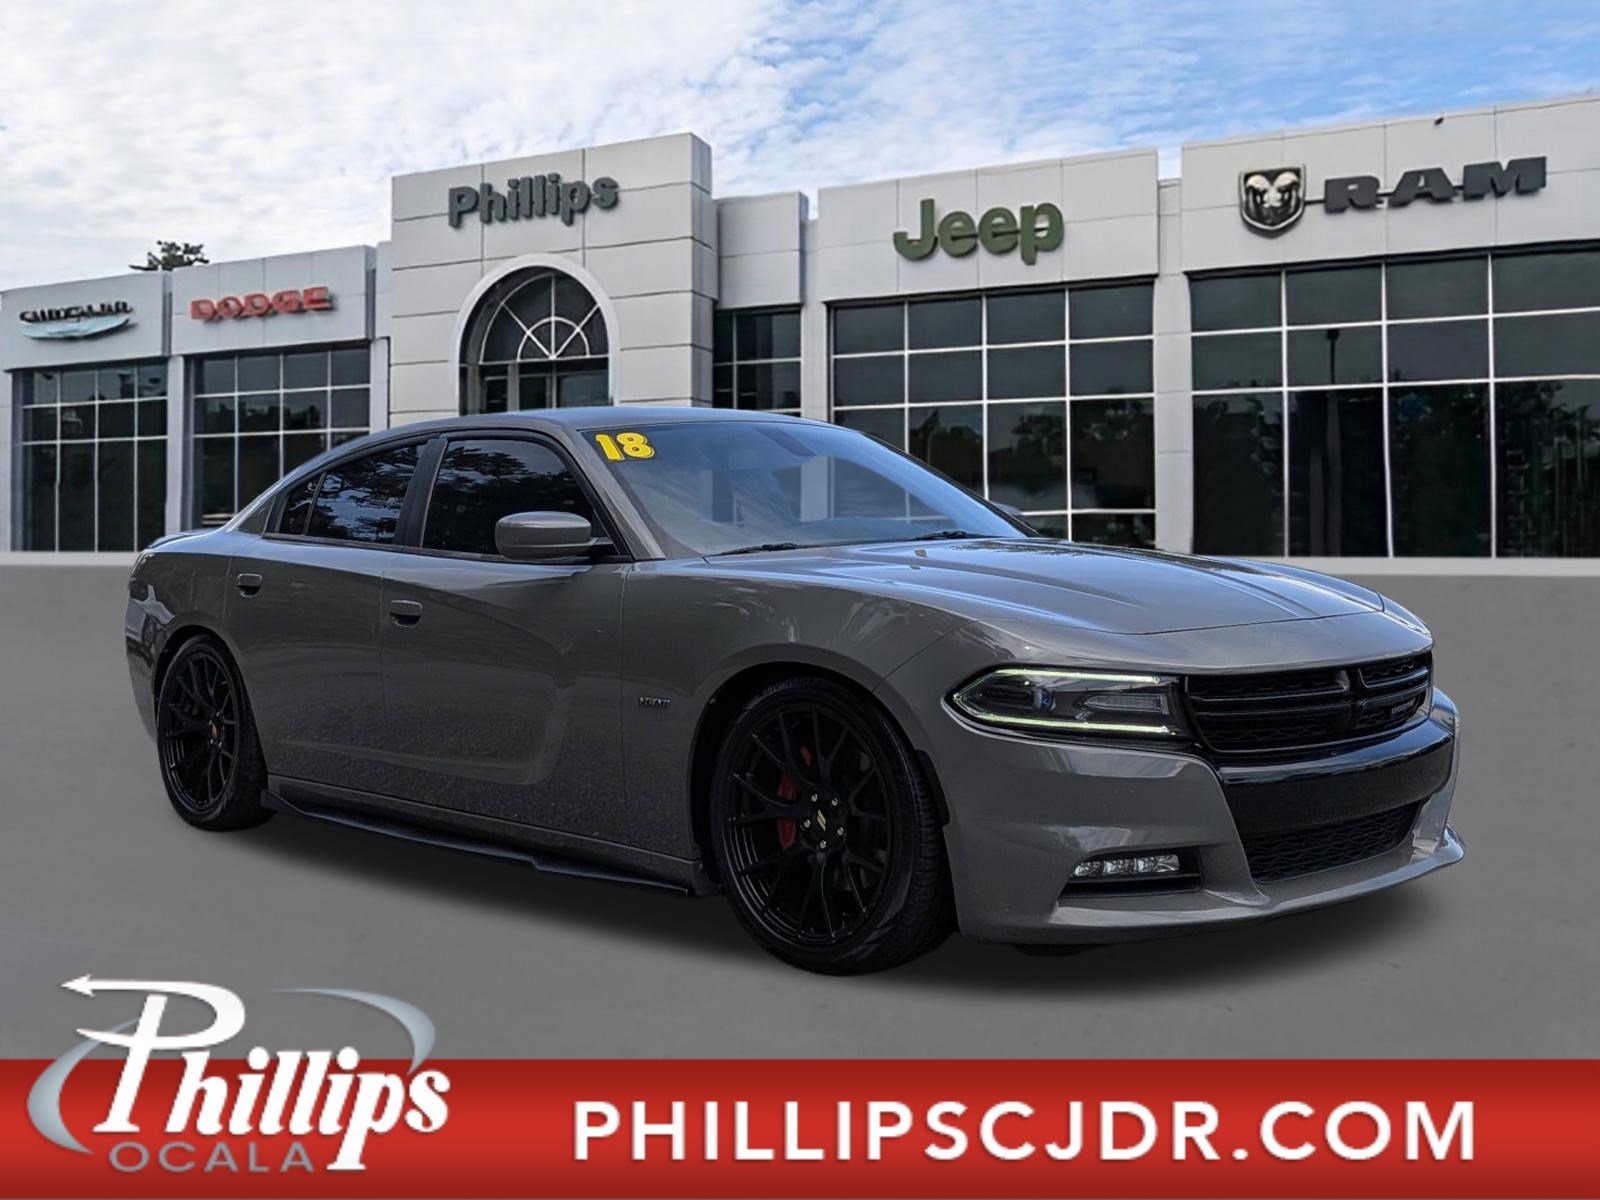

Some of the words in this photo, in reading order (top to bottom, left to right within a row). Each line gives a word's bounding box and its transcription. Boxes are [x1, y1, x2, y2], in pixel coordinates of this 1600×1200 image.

[449, 172, 619, 229] Phillips
[1324, 157, 1547, 213] RAM
[893, 198, 1065, 265] Jeep
[190, 286, 333, 321] DODGE
[595, 432, 655, 461] 18
